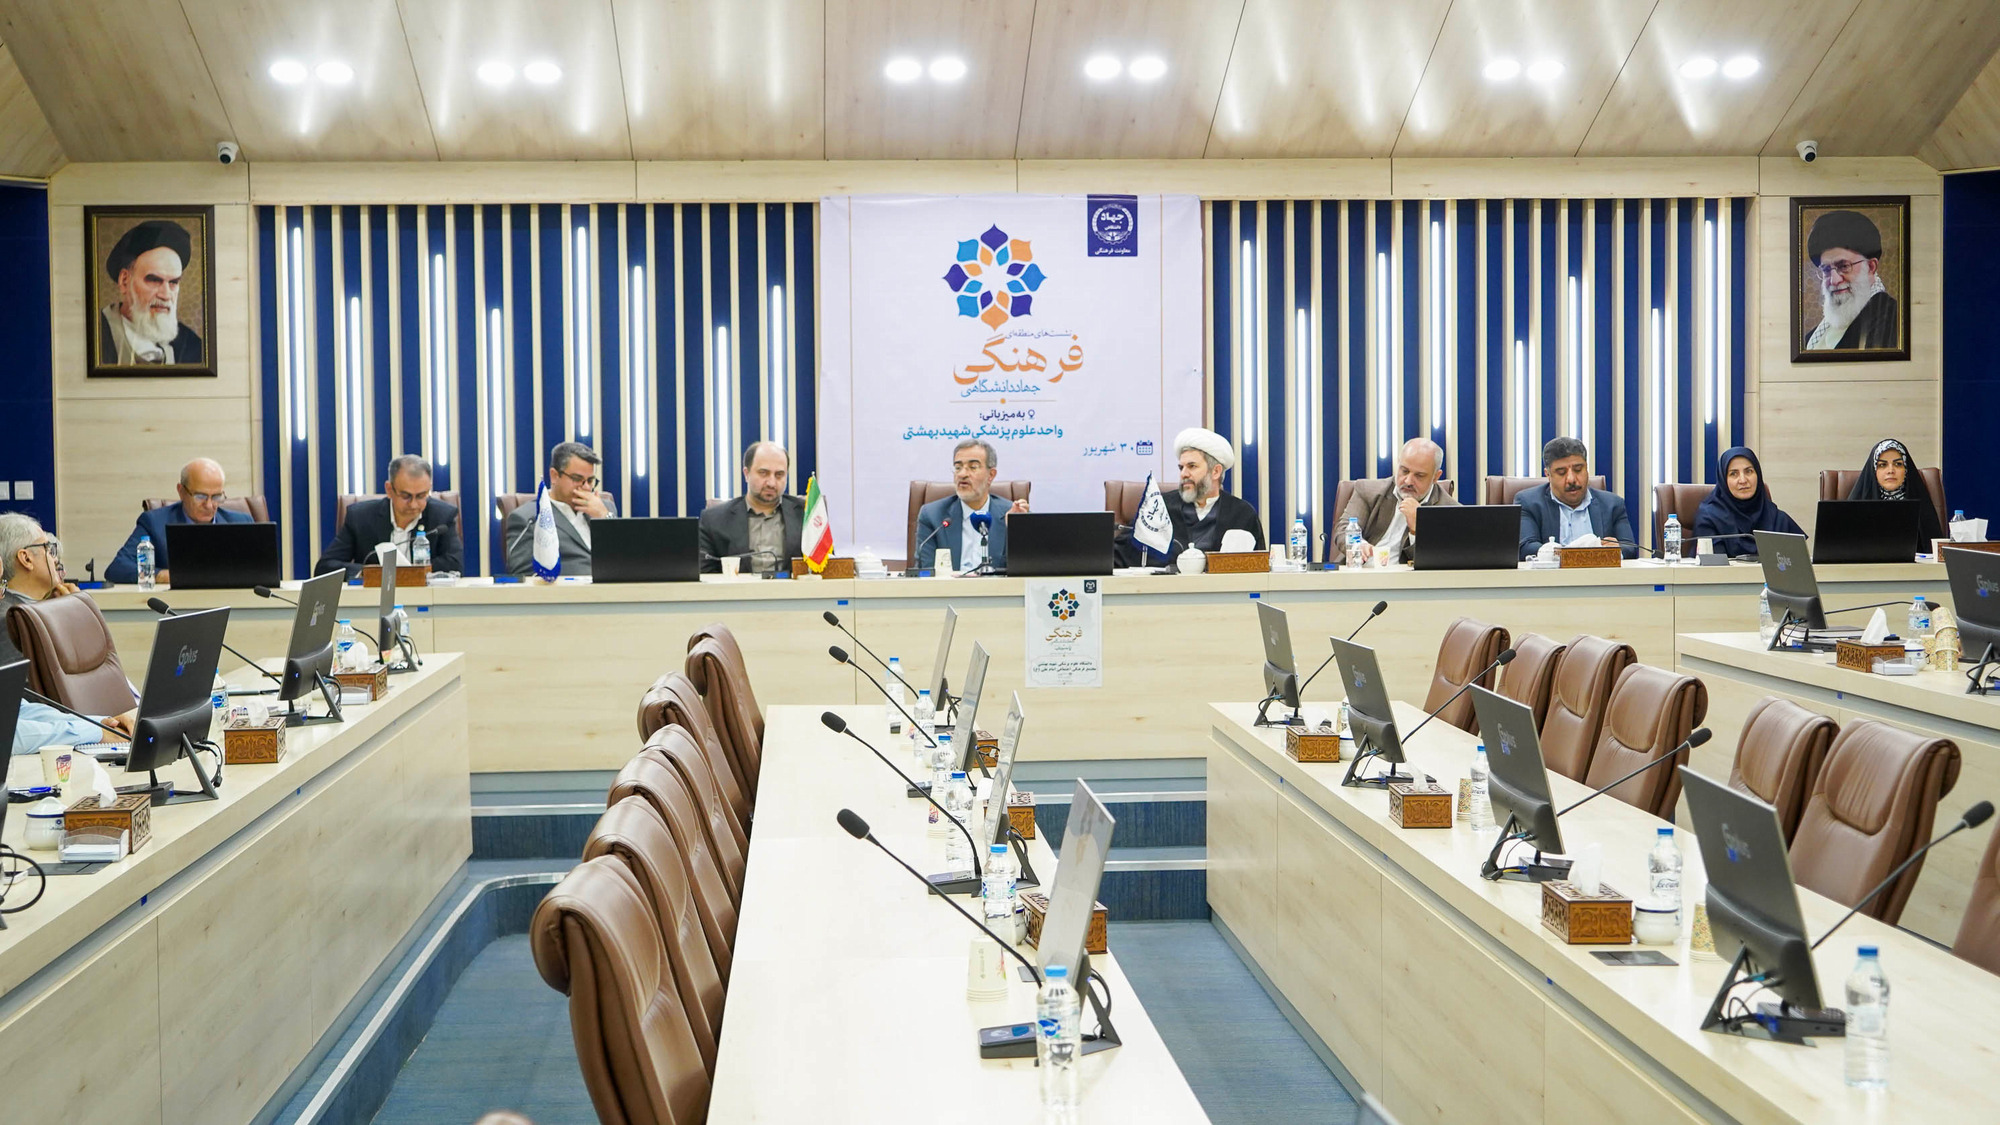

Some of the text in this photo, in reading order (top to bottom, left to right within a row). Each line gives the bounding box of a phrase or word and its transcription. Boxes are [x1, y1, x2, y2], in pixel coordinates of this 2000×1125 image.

[1100, 212, 1124, 224] جهاد
[953, 333, 1084, 385] فرهنگی
[902, 424, 1063, 441] واحد علوم پزشکی شهید بهشتی
[1082, 442, 1116, 457] شهریور
[1045, 626, 1082, 641] فرهنگی
